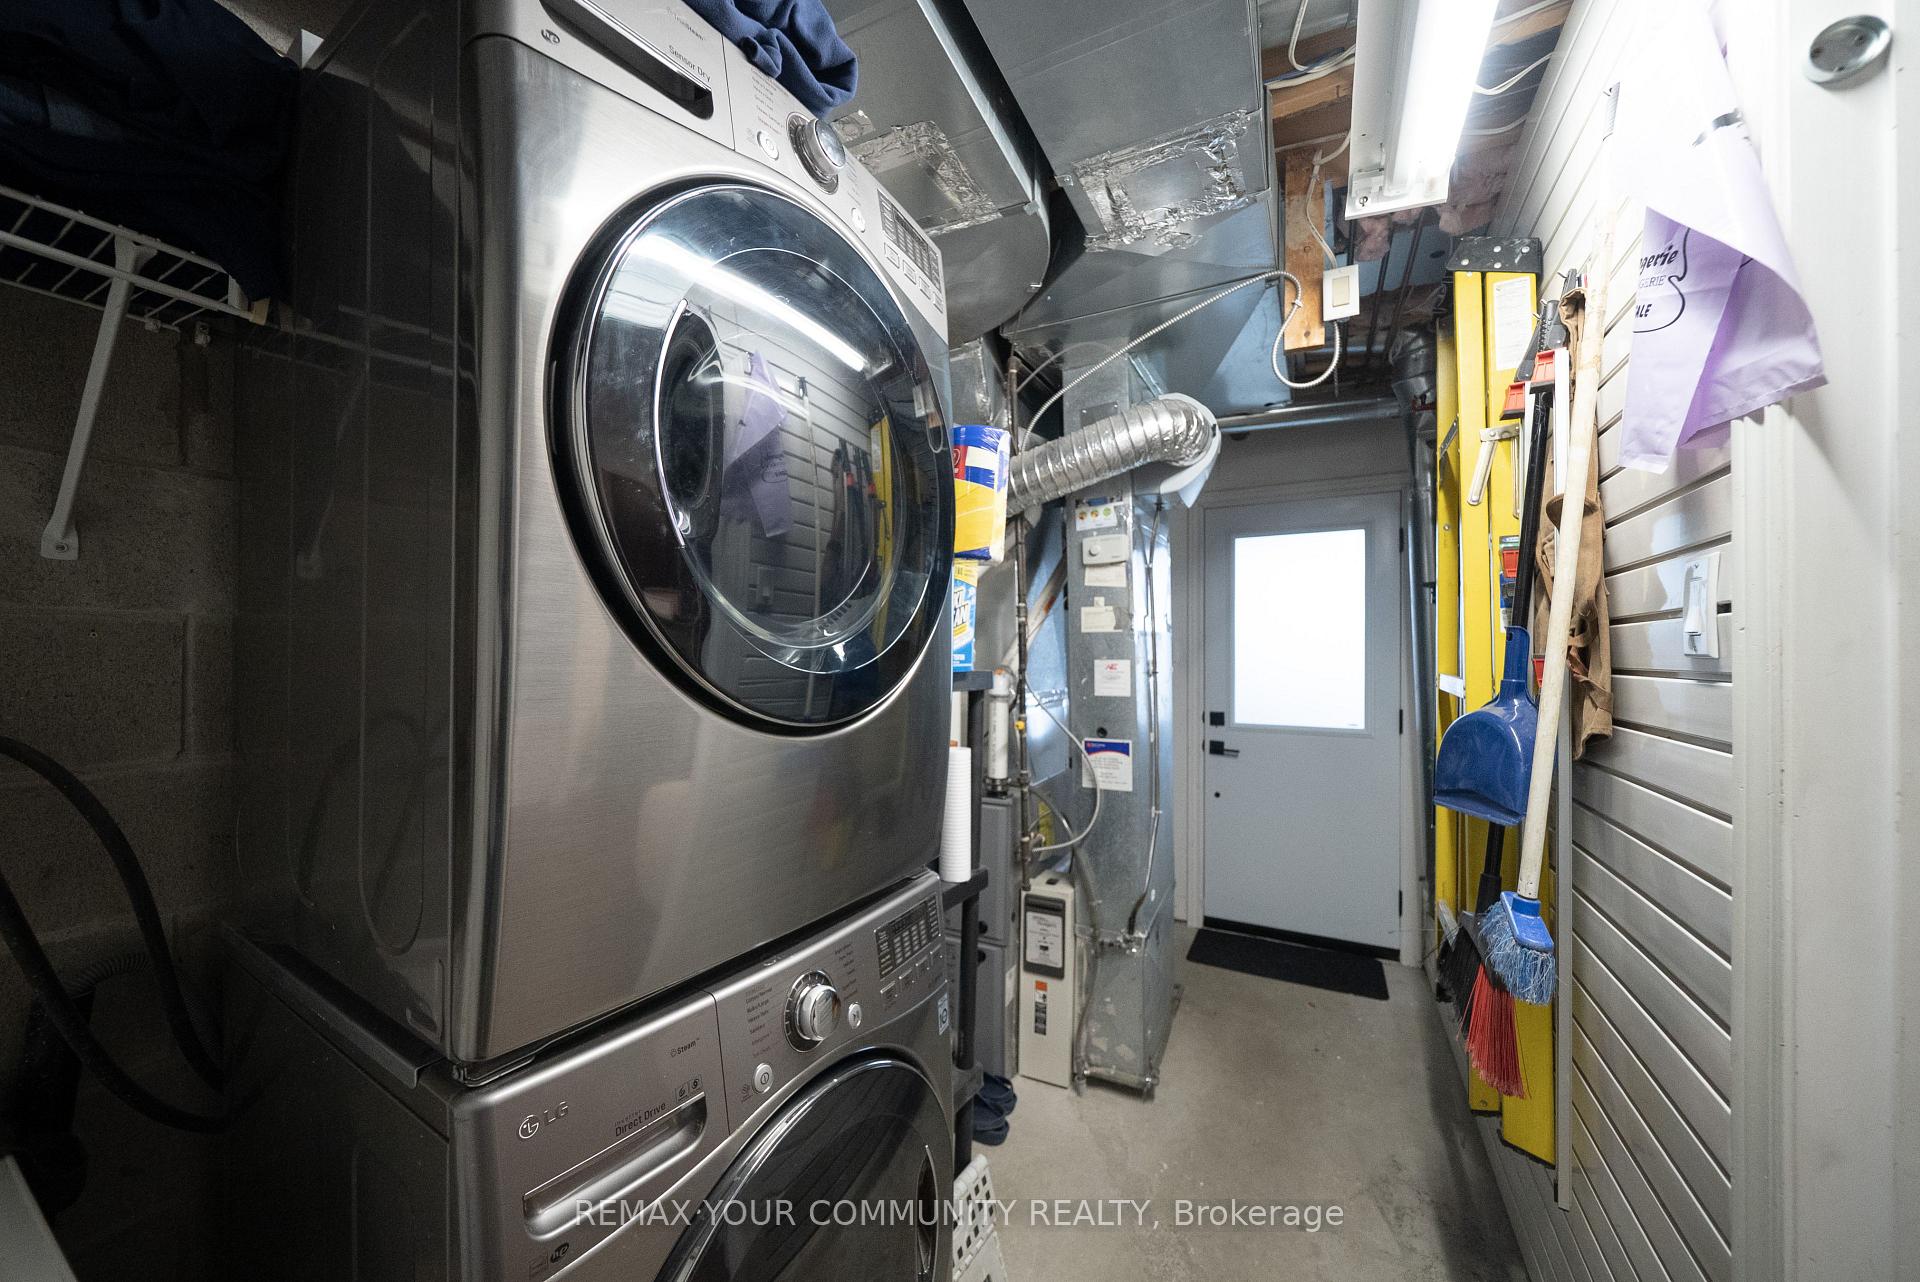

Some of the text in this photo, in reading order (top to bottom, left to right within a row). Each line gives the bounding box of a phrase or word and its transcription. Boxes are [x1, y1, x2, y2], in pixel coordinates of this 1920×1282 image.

[668, 44, 711, 83] Sensor Dry
[543, 1100, 569, 1126] LG
[615, 1102, 667, 1138] Direct Drive
